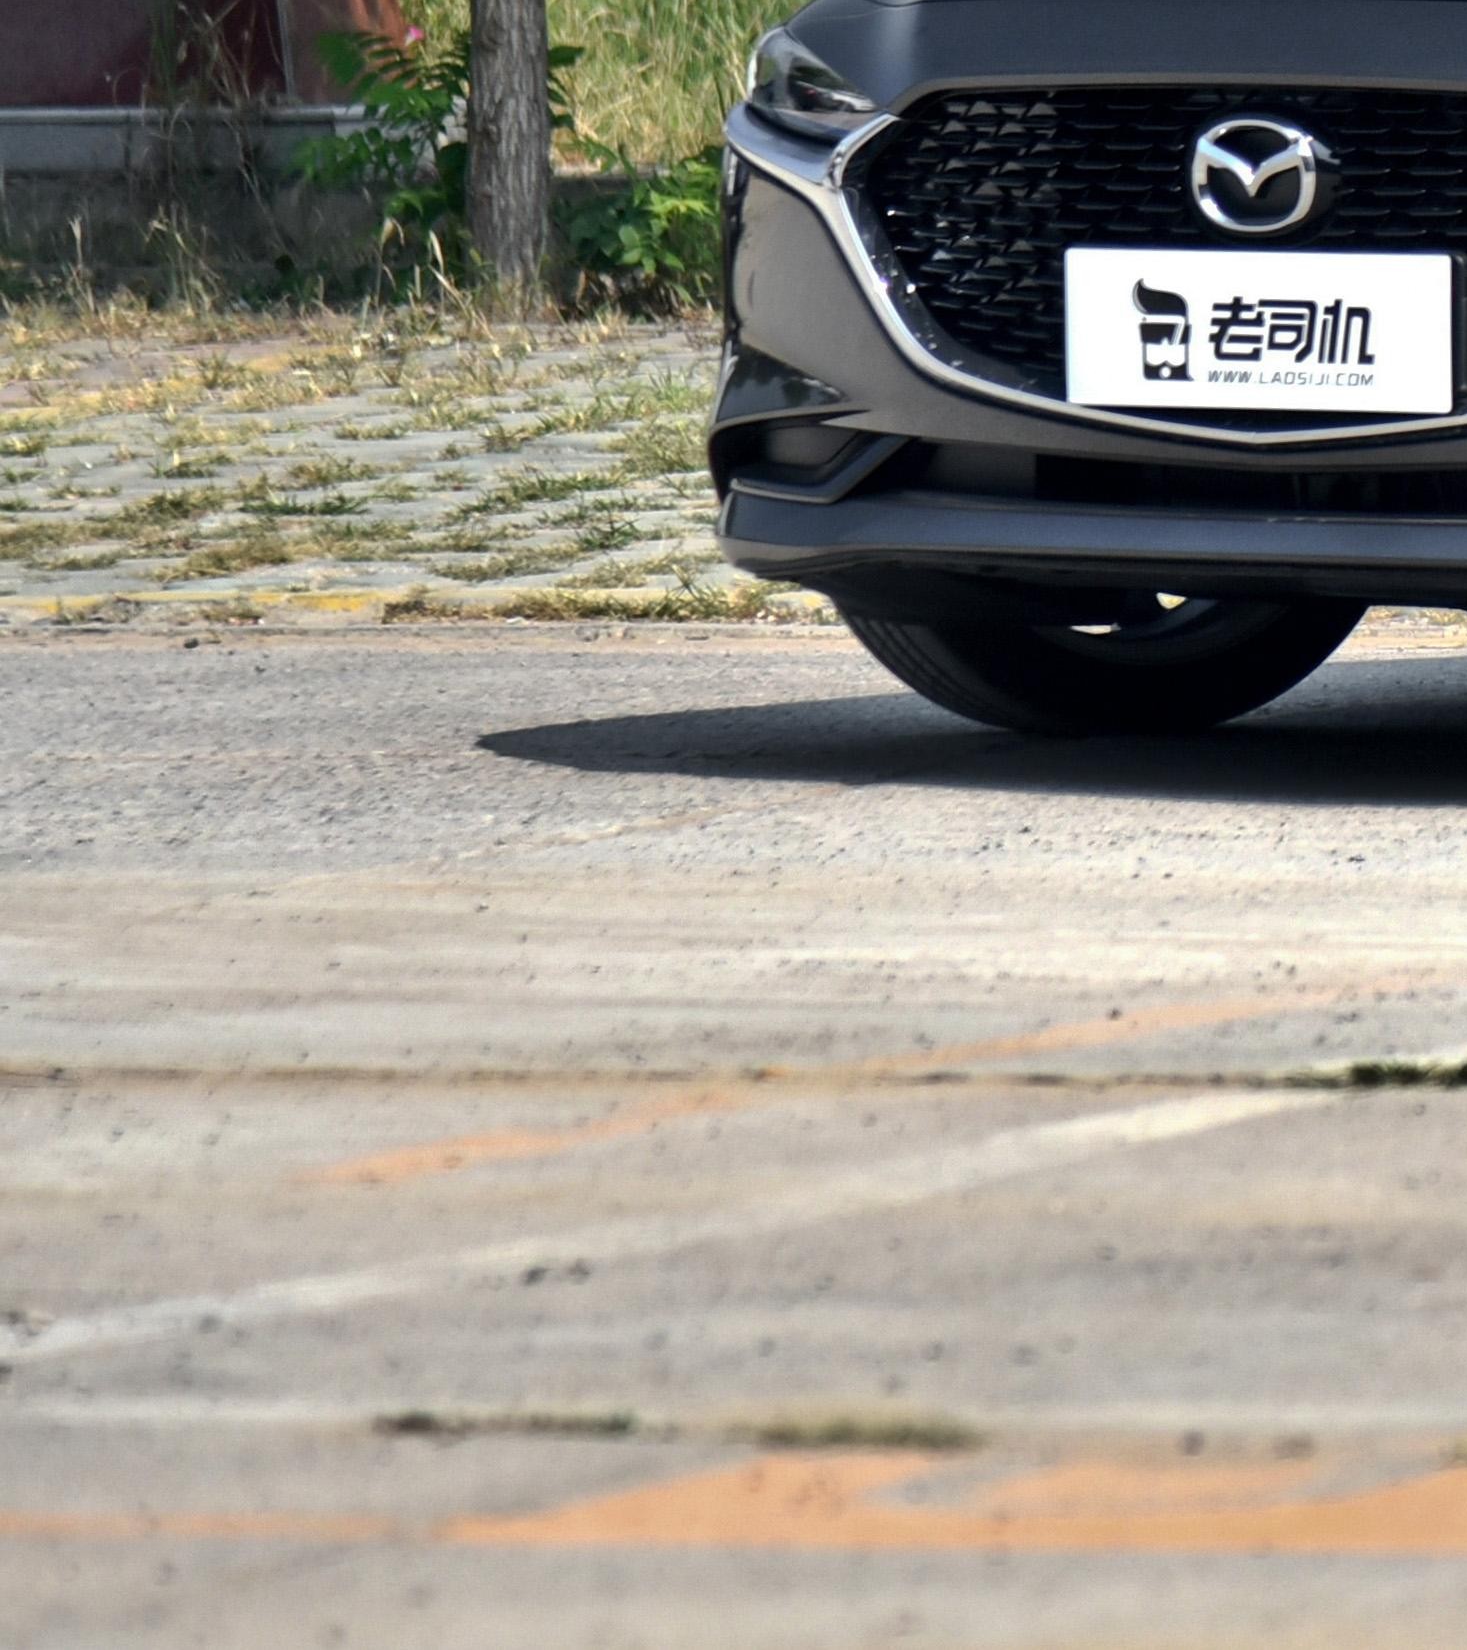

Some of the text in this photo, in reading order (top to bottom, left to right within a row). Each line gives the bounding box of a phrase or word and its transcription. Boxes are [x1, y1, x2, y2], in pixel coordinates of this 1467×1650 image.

[1208, 296, 1375, 365] 老司机
[1207, 370, 1374, 386] WWW.LAOSIJI.COM
